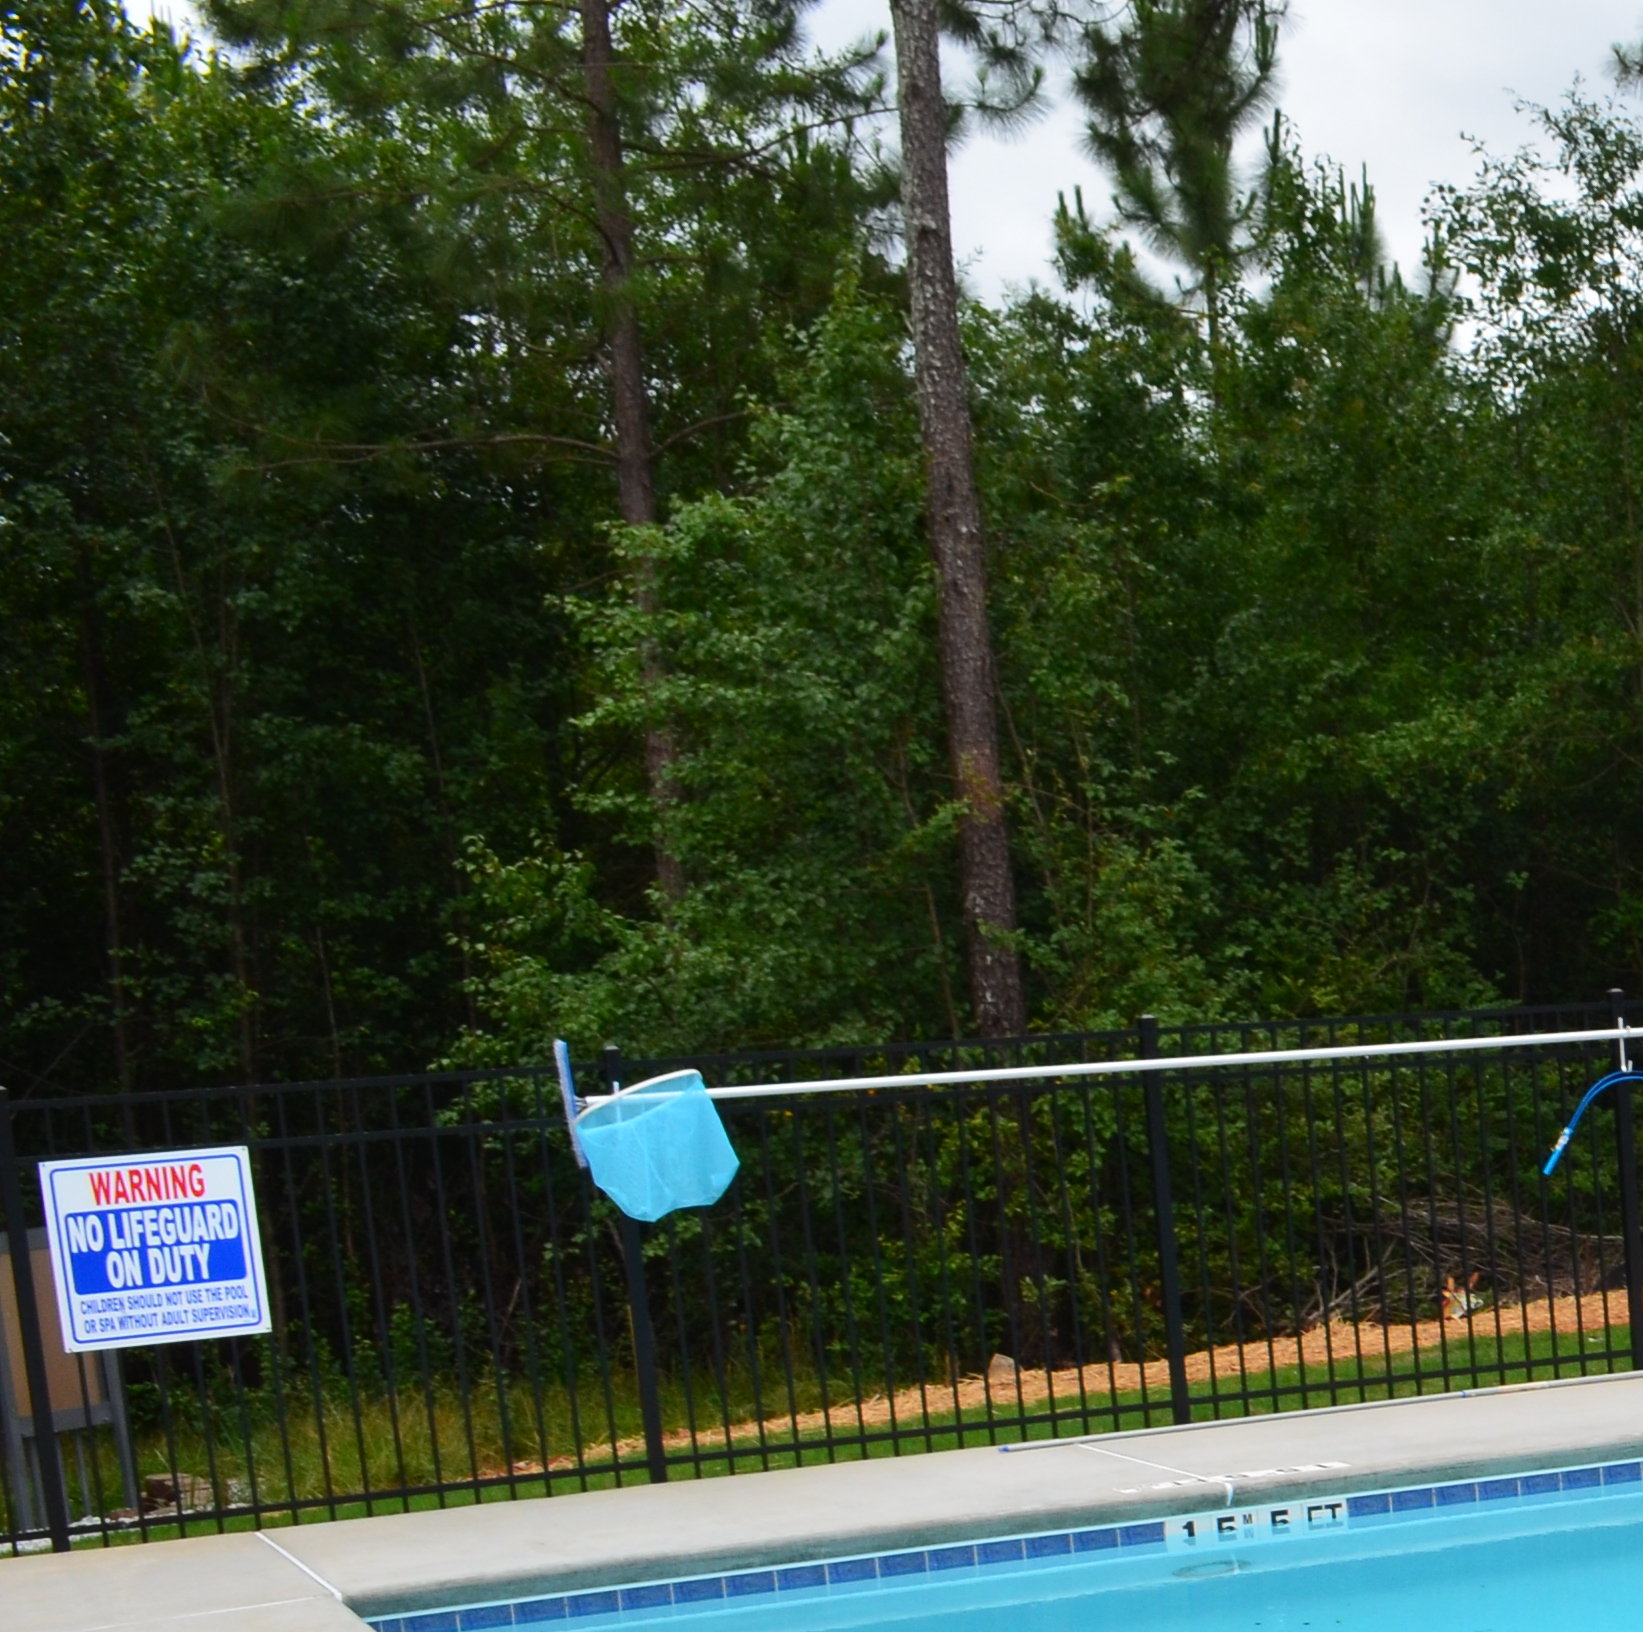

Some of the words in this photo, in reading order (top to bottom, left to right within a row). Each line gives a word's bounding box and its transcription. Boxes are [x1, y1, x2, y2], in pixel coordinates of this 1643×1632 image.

[89, 1164, 206, 1206] WARNING
[67, 1214, 104, 1253] NO
[108, 1203, 238, 1249] LIFEGUARD
[106, 1250, 143, 1289] ON
[148, 1243, 210, 1284] DUTY
[81, 1298, 125, 1315] CHILDREN
[128, 1293, 163, 1310] SHOULD
[166, 1291, 183, 1306] NOT
[187, 1289, 203, 1304] USE
[206, 1287, 222, 1301] THE
[225, 1285, 248, 1300] POOL
[84, 1320, 97, 1334] OR
[100, 1317, 117, 1333] SPA
[119, 1312, 158, 1331] WITHOUT
[162, 1310, 188, 1326] ADULT
[191, 1304, 250, 1323] SUPERVISION
